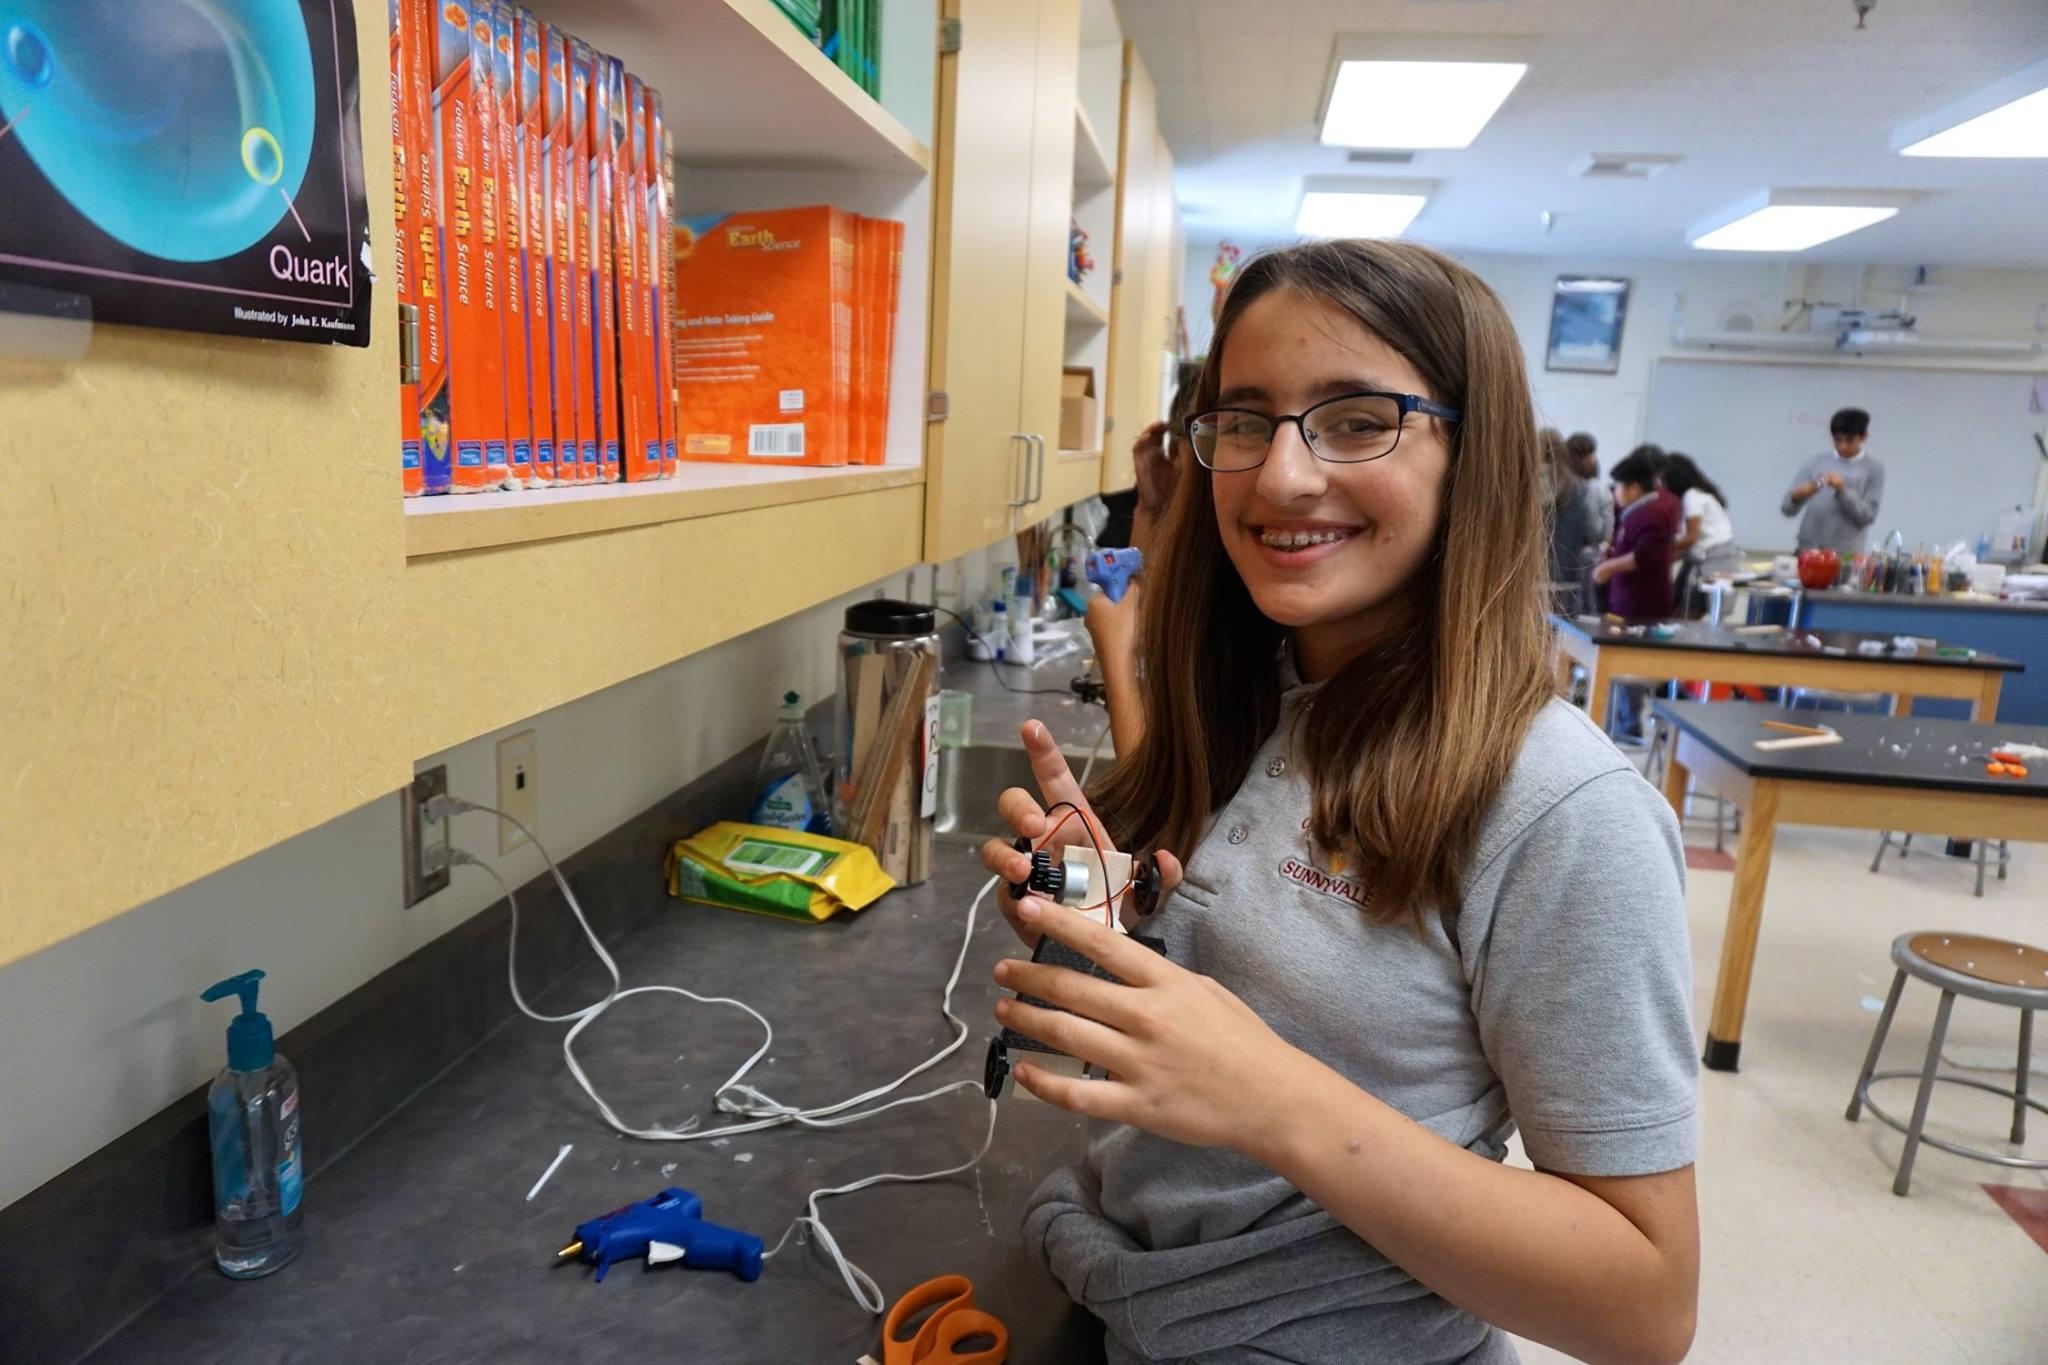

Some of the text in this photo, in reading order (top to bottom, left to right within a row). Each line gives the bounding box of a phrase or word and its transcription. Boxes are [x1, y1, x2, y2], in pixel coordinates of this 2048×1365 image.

[392, 145, 406, 221] Earth
[420, 153, 432, 219] Science
[454, 99, 471, 306] Focus on Earth Science
[481, 176, 496, 246] Earth
[419, 225, 437, 298] Earth
[728, 230, 775, 248] Earth
[270, 245, 350, 289] Quark
[483, 249, 496, 312] Science
[508, 255, 520, 314] Science
[535, 261, 545, 318] Science
[233, 306, 277, 323] Illustrated
[277, 311, 288, 327] by
[291, 314, 311, 328] John
[428, 304, 437, 322] on
[559, 268, 569, 322] Science
[623, 282, 634, 331] Science
[428, 325, 439, 364] Focus
[1283, 860, 1375, 908] SUNNYVALE
